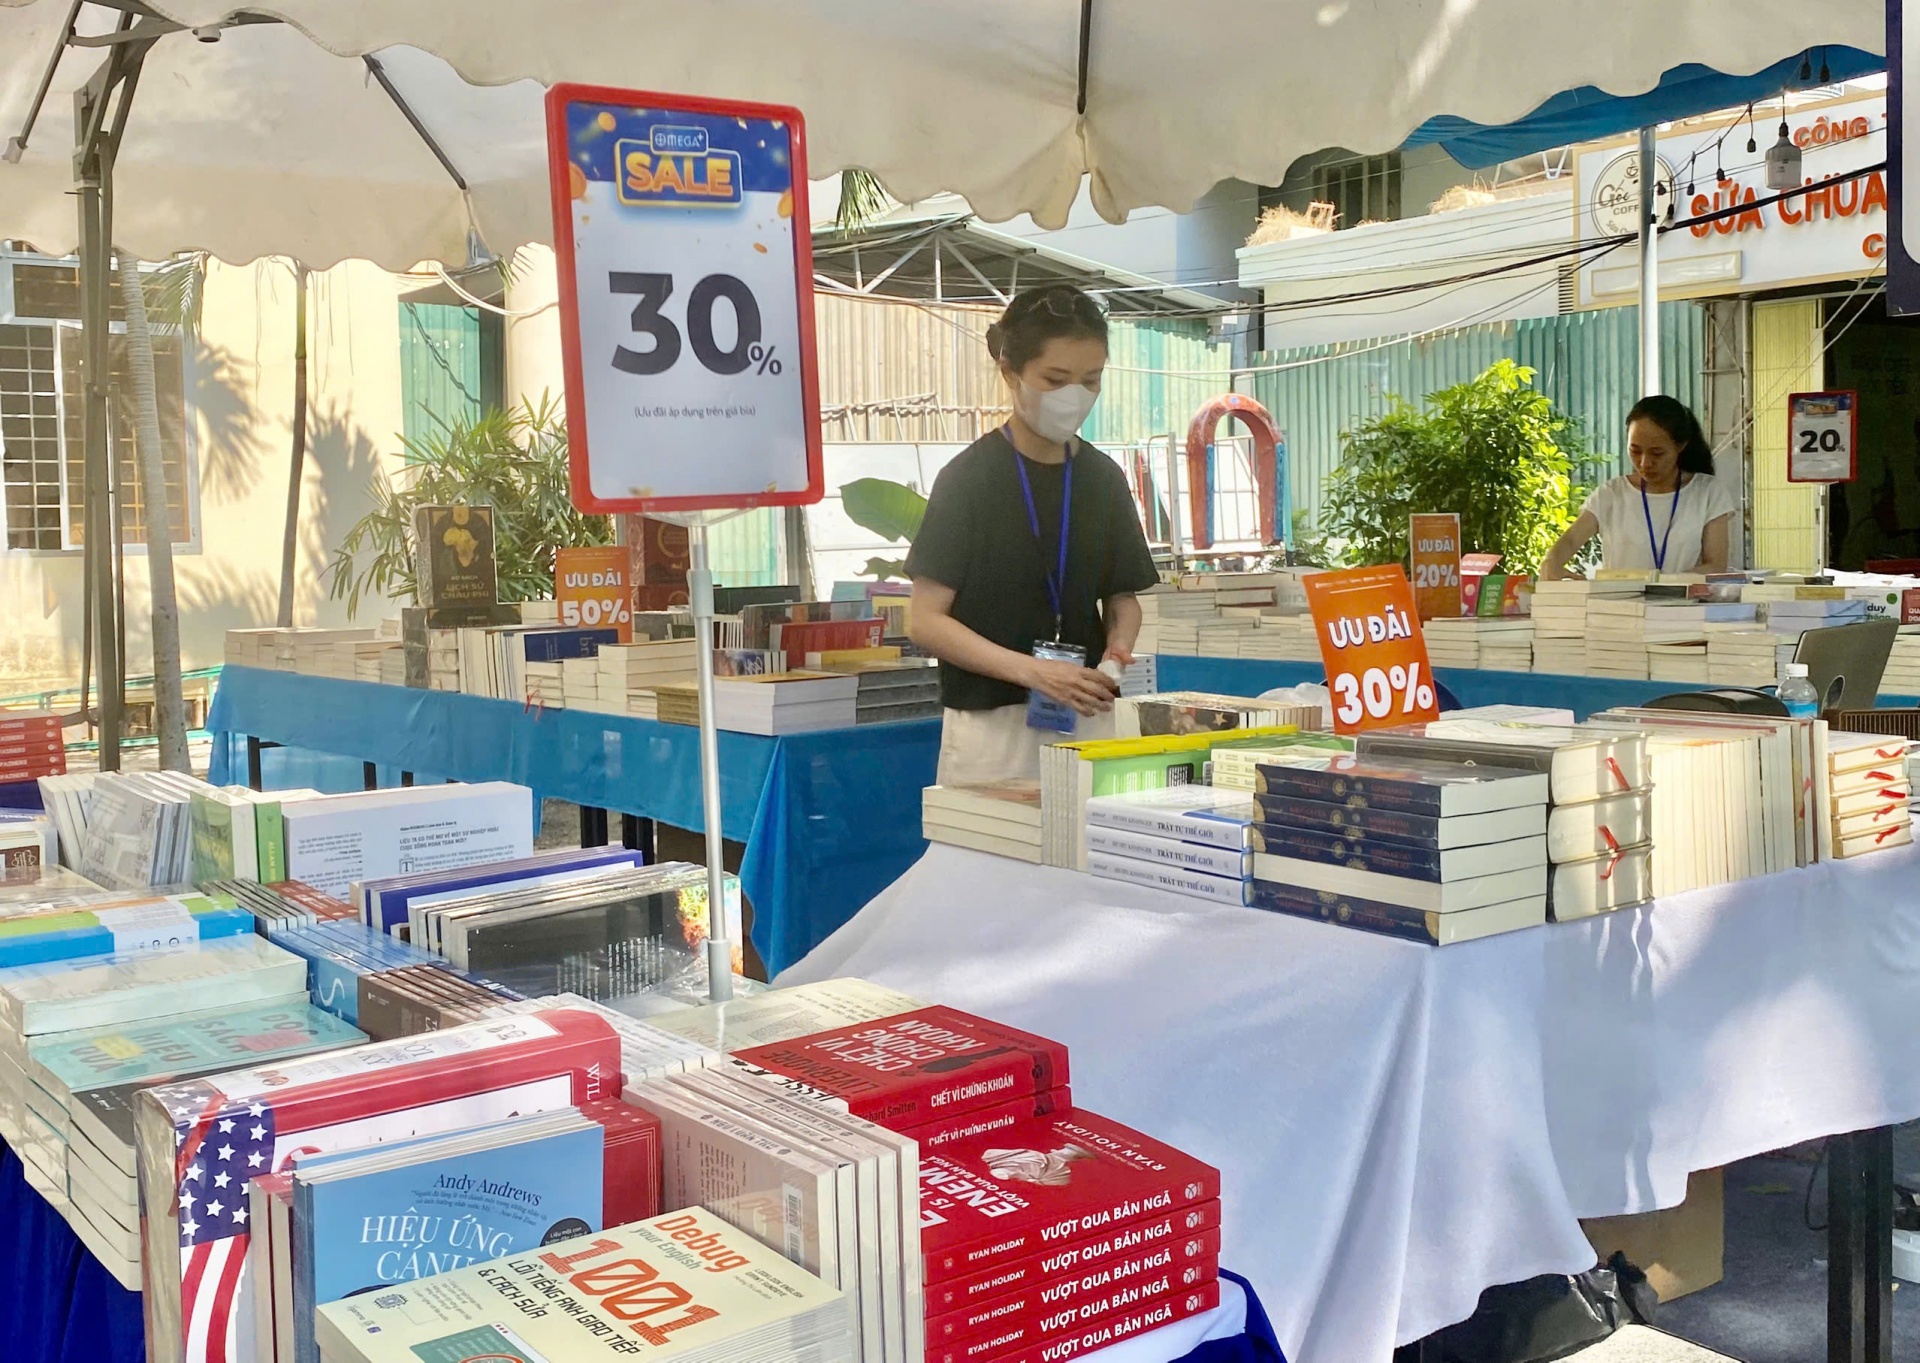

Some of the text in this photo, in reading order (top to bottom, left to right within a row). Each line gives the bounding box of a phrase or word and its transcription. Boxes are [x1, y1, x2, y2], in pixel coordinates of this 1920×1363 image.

[1794, 116, 1869, 148] CÔNG
[625, 151, 733, 197] SALE
[608, 270, 782, 376] 30%
[1799, 429, 1846, 453] 20%
[1418, 535, 1454, 552] ƯU ĐÃI
[565, 568, 622, 588] ƯU ĐÃI
[1416, 564, 1458, 588] 20%
[562, 599, 629, 626] 50%
[1328, 604, 1412, 648] ƯU ĐÃI
[1867, 603, 1886, 614] duy
[1334, 661, 1433, 725] 30%
[1185, 824, 1198, 835] THẾ
[1185, 852, 1197, 863] THẾ
[1186, 880, 1199, 890] THẾ
[852, 1028, 946, 1061] CHỨNG
[889, 1019, 986, 1052] KHOÁN
[760, 1049, 879, 1095] LIVERMORE
[804, 1036, 913, 1073] CHẾT VÌ
[930, 1073, 1014, 1108] CHẾT VÌ CHỨNG KHOÁN
[887, 1101, 917, 1118] Smitten
[1053, 1120, 1167, 1171] RYAN HOLIDAY
[433, 1173, 542, 1207] Andy Andrews
[924, 1154, 1030, 1208] VƯỢT QUA BẢN NGÃ
[928, 1197, 955, 1211] IS
[1040, 1189, 1171, 1242] VƯỢT QUA BẢN NGÃ
[359, 1206, 515, 1258] HIỆU ỨNG
[628, 1226, 703, 1271] your English
[654, 1215, 751, 1273] Debug
[968, 1237, 1025, 1261] RYAN HOLIDAY
[1041, 1219, 1172, 1273] VƯỢT QUA BẢN NGÃ
[477, 1268, 497, 1278] &
[487, 1275, 526, 1300] CÁCH
[513, 1298, 550, 1319] SỬA
[538, 1238, 721, 1347] 1001
[968, 1269, 1025, 1295] RYAN HOLIDAY
[1040, 1250, 1172, 1304] VƯỢT QUA BẢN NGÃ
[526, 1272, 566, 1300] TIẾNG
[554, 1296, 584, 1317] ANH
[576, 1314, 614, 1337] GIAO
[604, 1334, 645, 1355] TIẾP
[968, 1300, 1025, 1326] RYAN HOLIDAY
[1039, 1277, 1170, 1333] VƯỢT QUA BẢN NGÃ
[967, 1329, 1024, 1355] RYAN HOLIDAY
[1041, 1305, 1173, 1363] VƯỢT QUA BẢN NGÃ
